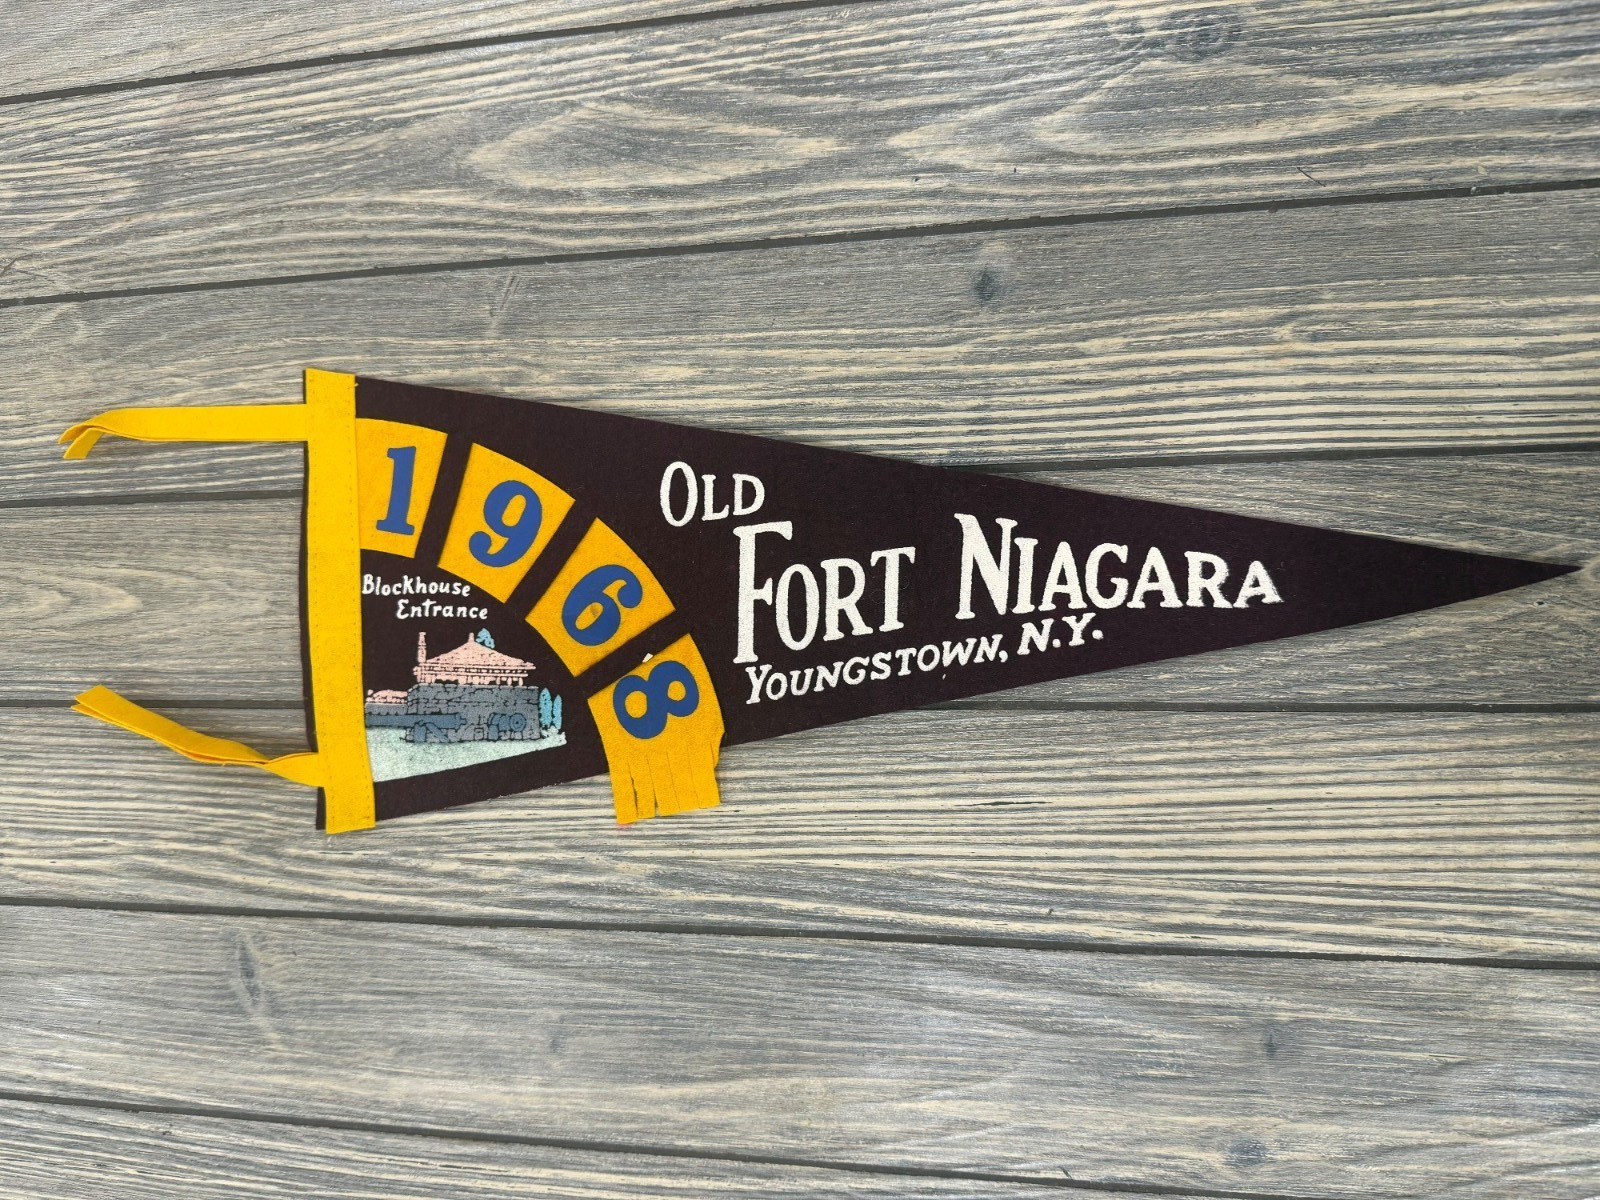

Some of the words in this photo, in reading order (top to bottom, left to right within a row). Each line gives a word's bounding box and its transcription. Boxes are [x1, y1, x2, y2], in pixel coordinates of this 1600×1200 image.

[659, 460, 766, 528] OLD
[361, 573, 471, 597] Blockhouse
[396, 598, 489, 620] Entrance
[732, 520, 917, 664] FORT
[953, 512, 1284, 620] NIAGARA
[745, 633, 1009, 705] YOUNGSTOWN,
[1016, 612, 1105, 656] N.Y.
